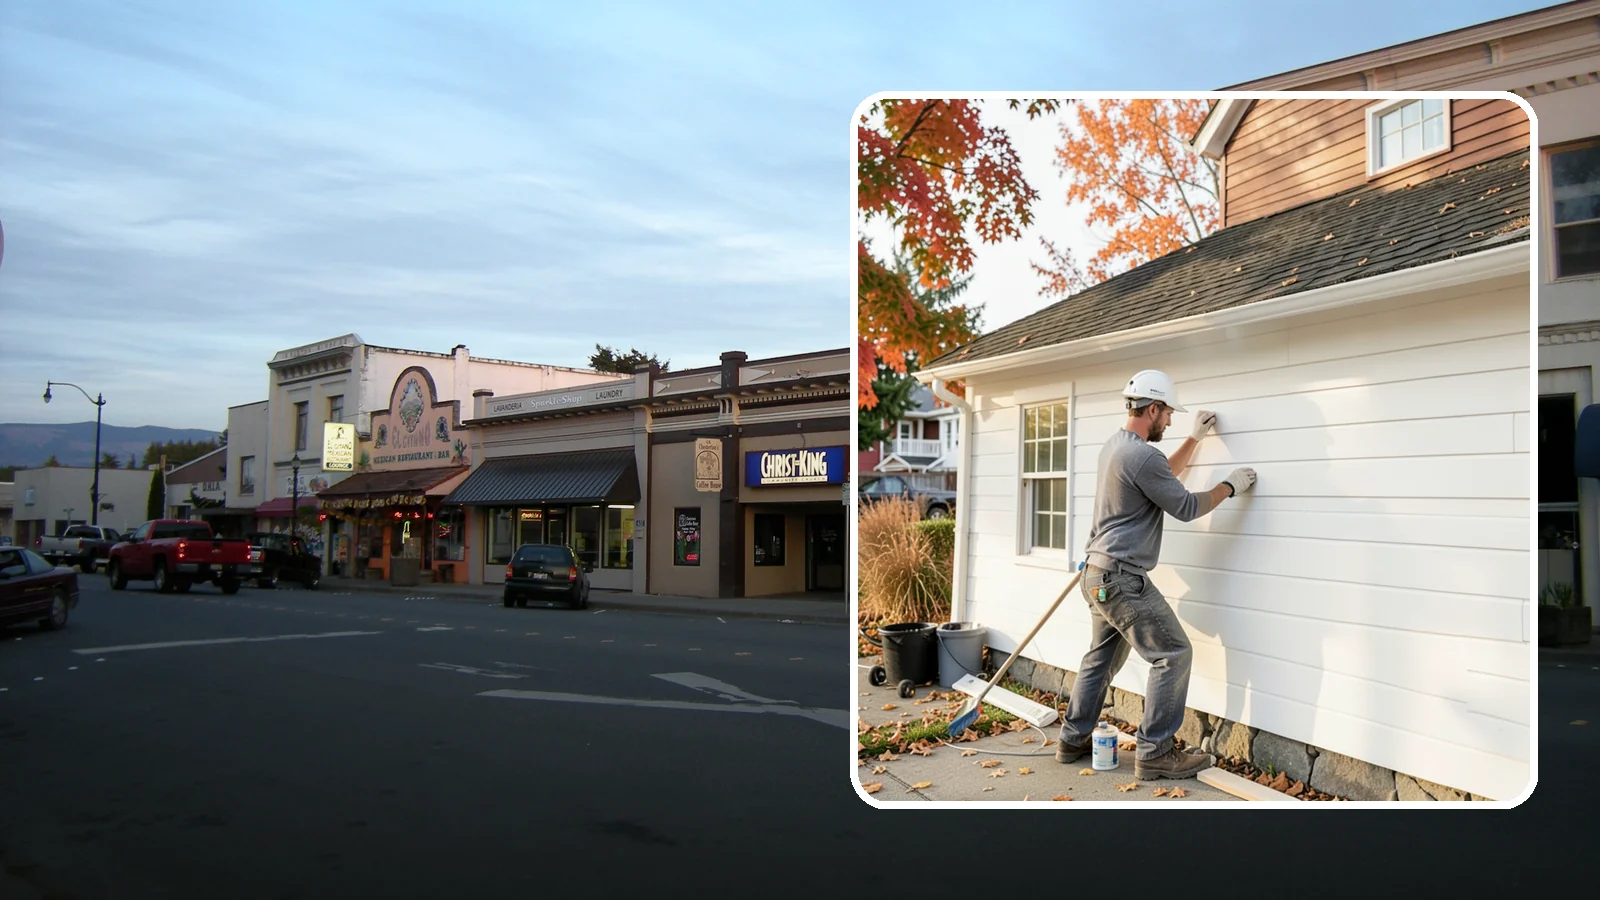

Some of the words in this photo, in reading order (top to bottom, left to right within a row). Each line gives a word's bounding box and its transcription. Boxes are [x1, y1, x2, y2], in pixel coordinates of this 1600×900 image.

[596, 389, 623, 400] LAUNDRY
[562, 395, 582, 406] Shop
[493, 402, 522, 413] LAVANDERIA
[373, 455, 398, 464] MEXICAN
[397, 451, 434, 462] RESTAURANT
[438, 450, 450, 459] BAR
[761, 452, 797, 478] CHRIST
[799, 450, 827, 476] KING
[696, 480, 709, 489] Coffee
[710, 480, 722, 489] House
